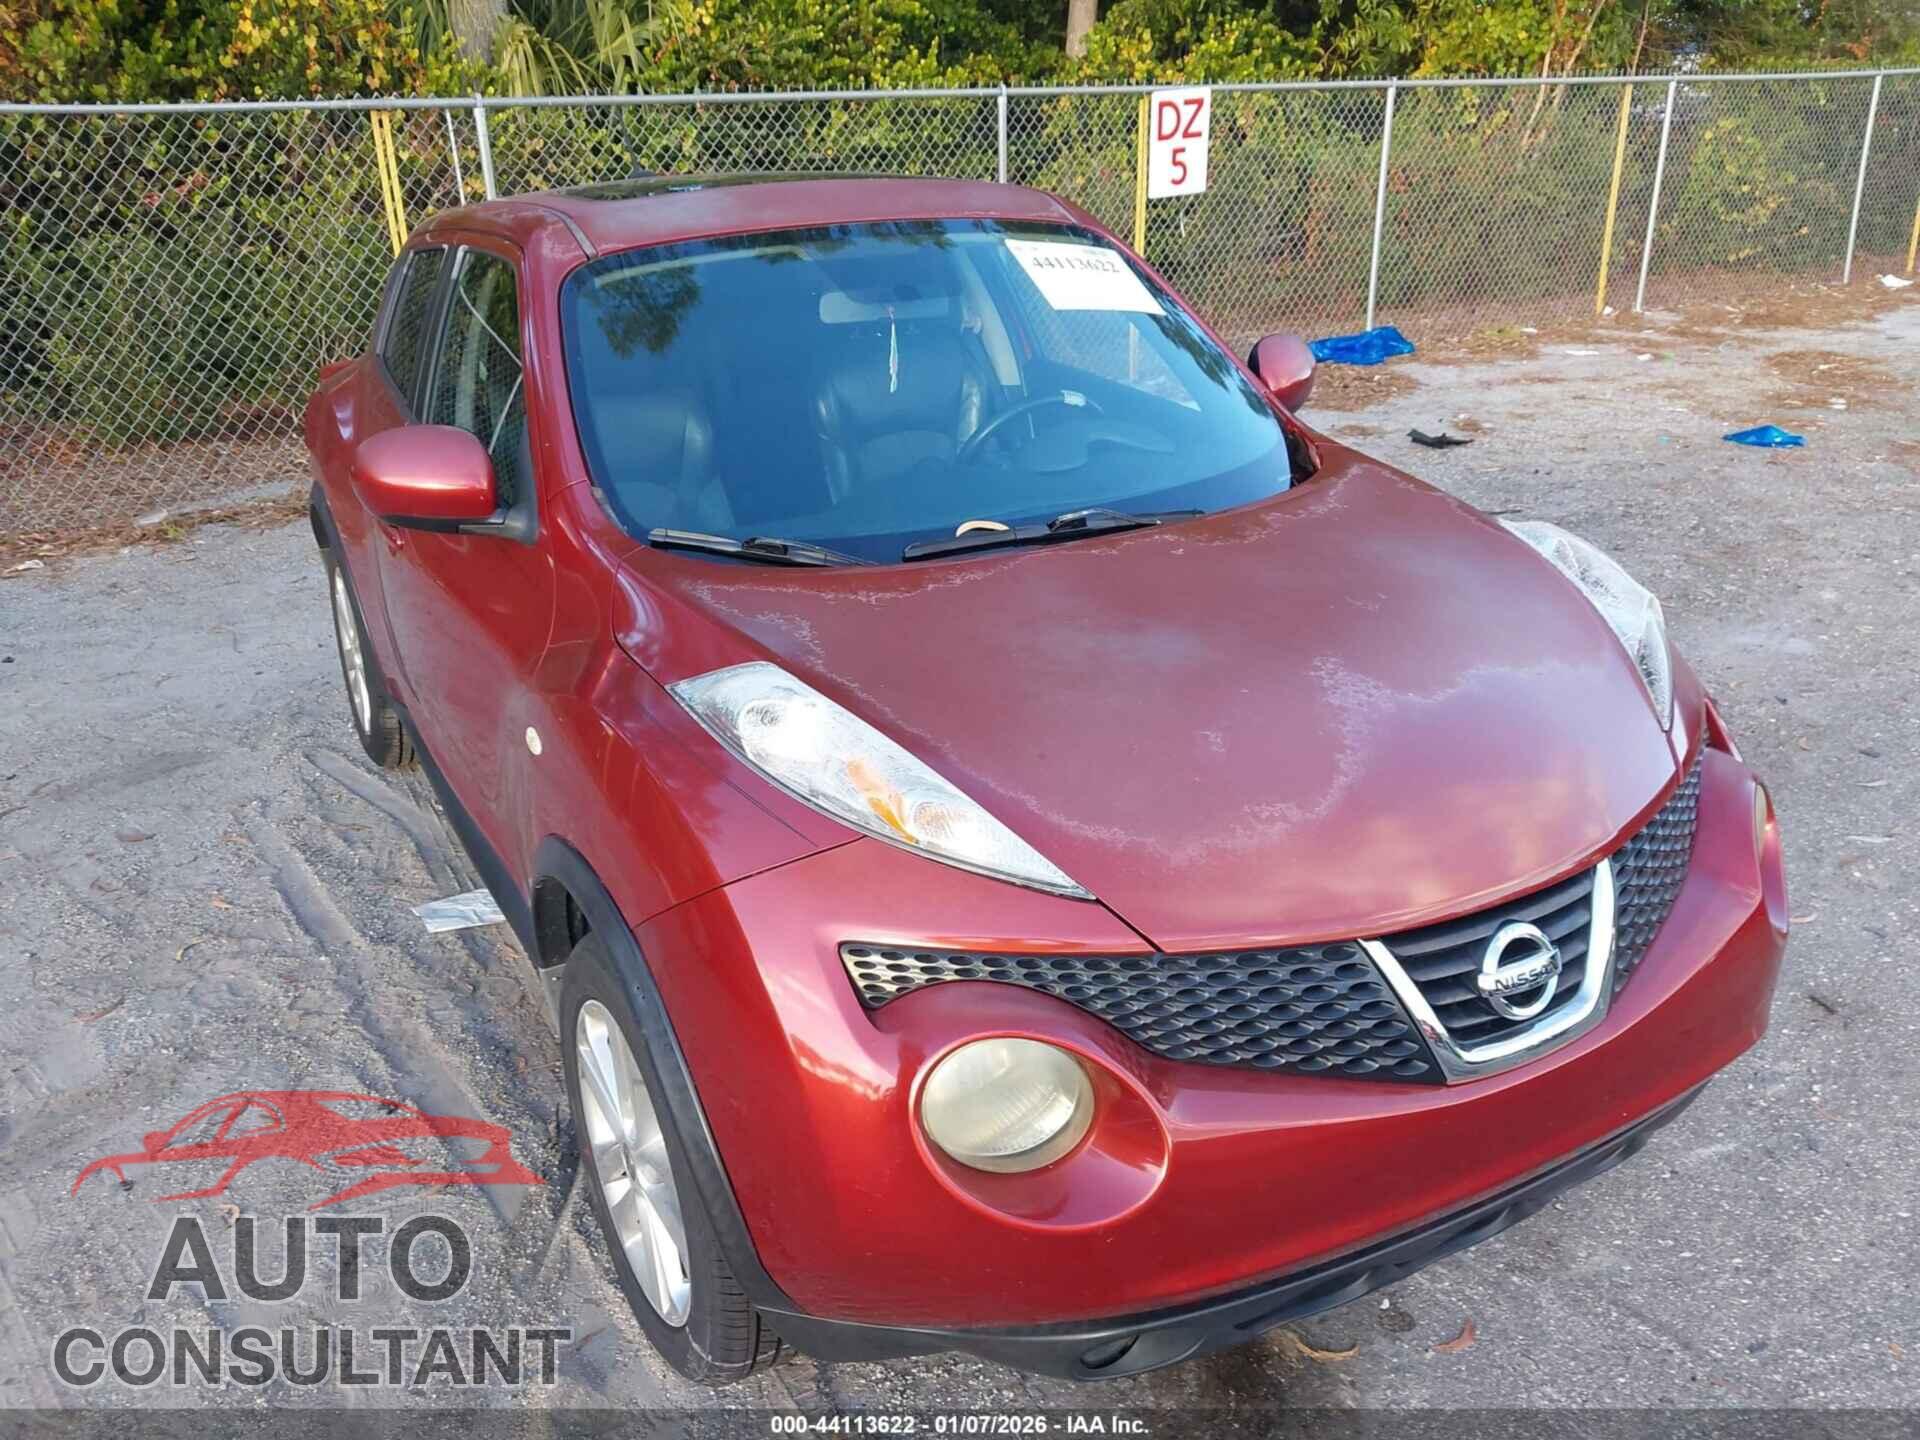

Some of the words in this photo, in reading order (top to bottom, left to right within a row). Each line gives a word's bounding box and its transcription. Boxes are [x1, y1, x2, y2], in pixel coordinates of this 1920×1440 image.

[1157, 98, 1204, 141] DZ
[1171, 147, 1187, 185] 5
[1032, 257, 1120, 273] 44113622
